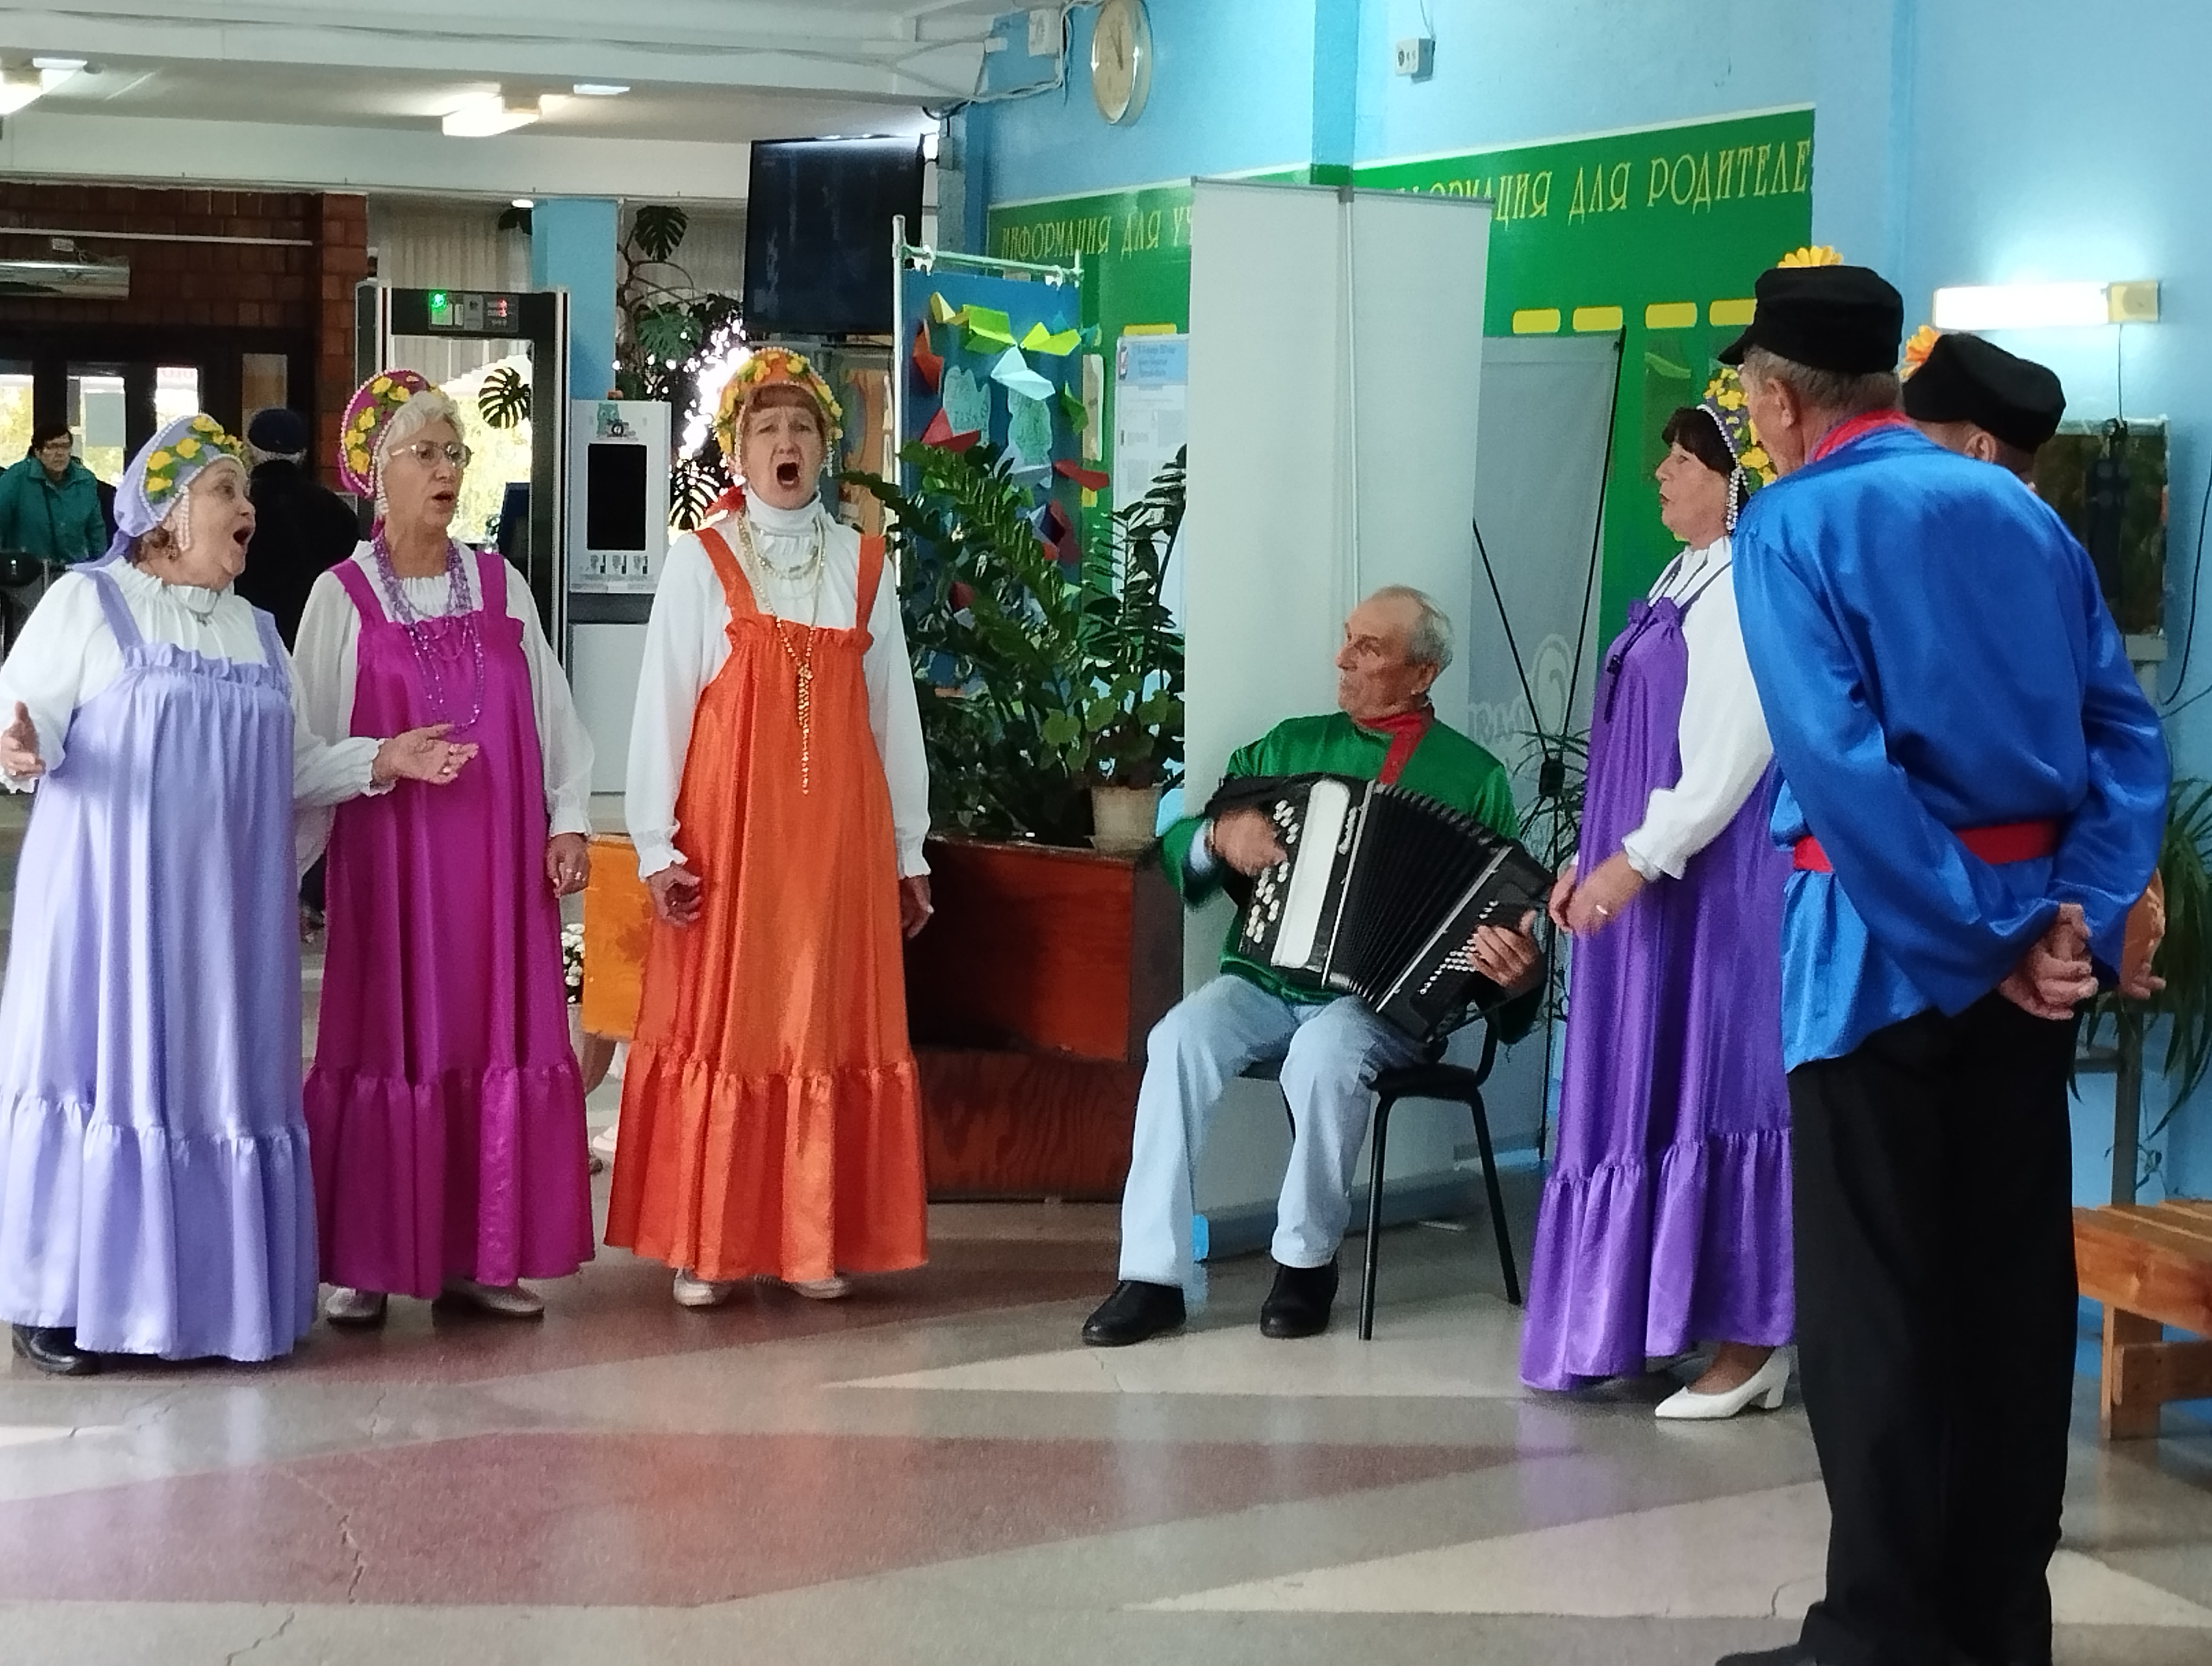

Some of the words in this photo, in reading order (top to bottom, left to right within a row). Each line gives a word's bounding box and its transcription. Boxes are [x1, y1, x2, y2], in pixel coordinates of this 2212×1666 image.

[1567, 162, 1631, 226] ДЛЯ
[1647, 138, 1811, 215] РОДИТЕЛЕ
[1001, 215, 1112, 262] ИНФОРМАЦИЯ
[1120, 209, 1161, 262] ДЛЯ
